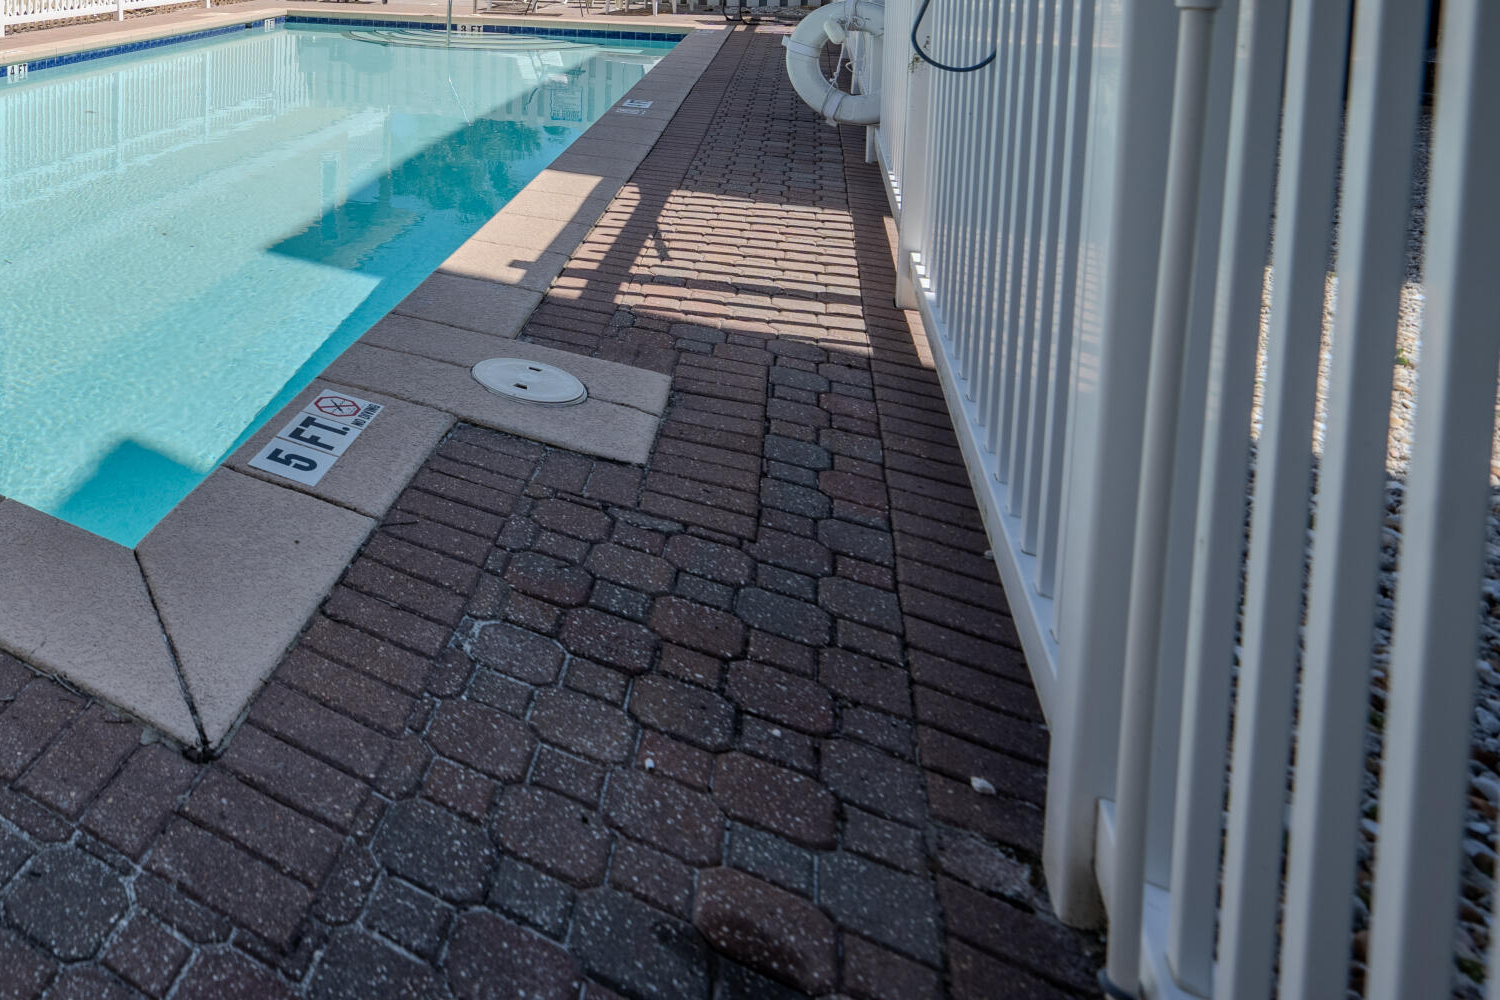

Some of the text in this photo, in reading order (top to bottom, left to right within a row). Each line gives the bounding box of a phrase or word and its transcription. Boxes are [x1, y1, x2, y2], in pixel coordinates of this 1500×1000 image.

[18, 64, 27, 73] FT
[351, 403, 380, 427] NO DIVING
[266, 415, 350, 472] 5 FT.
